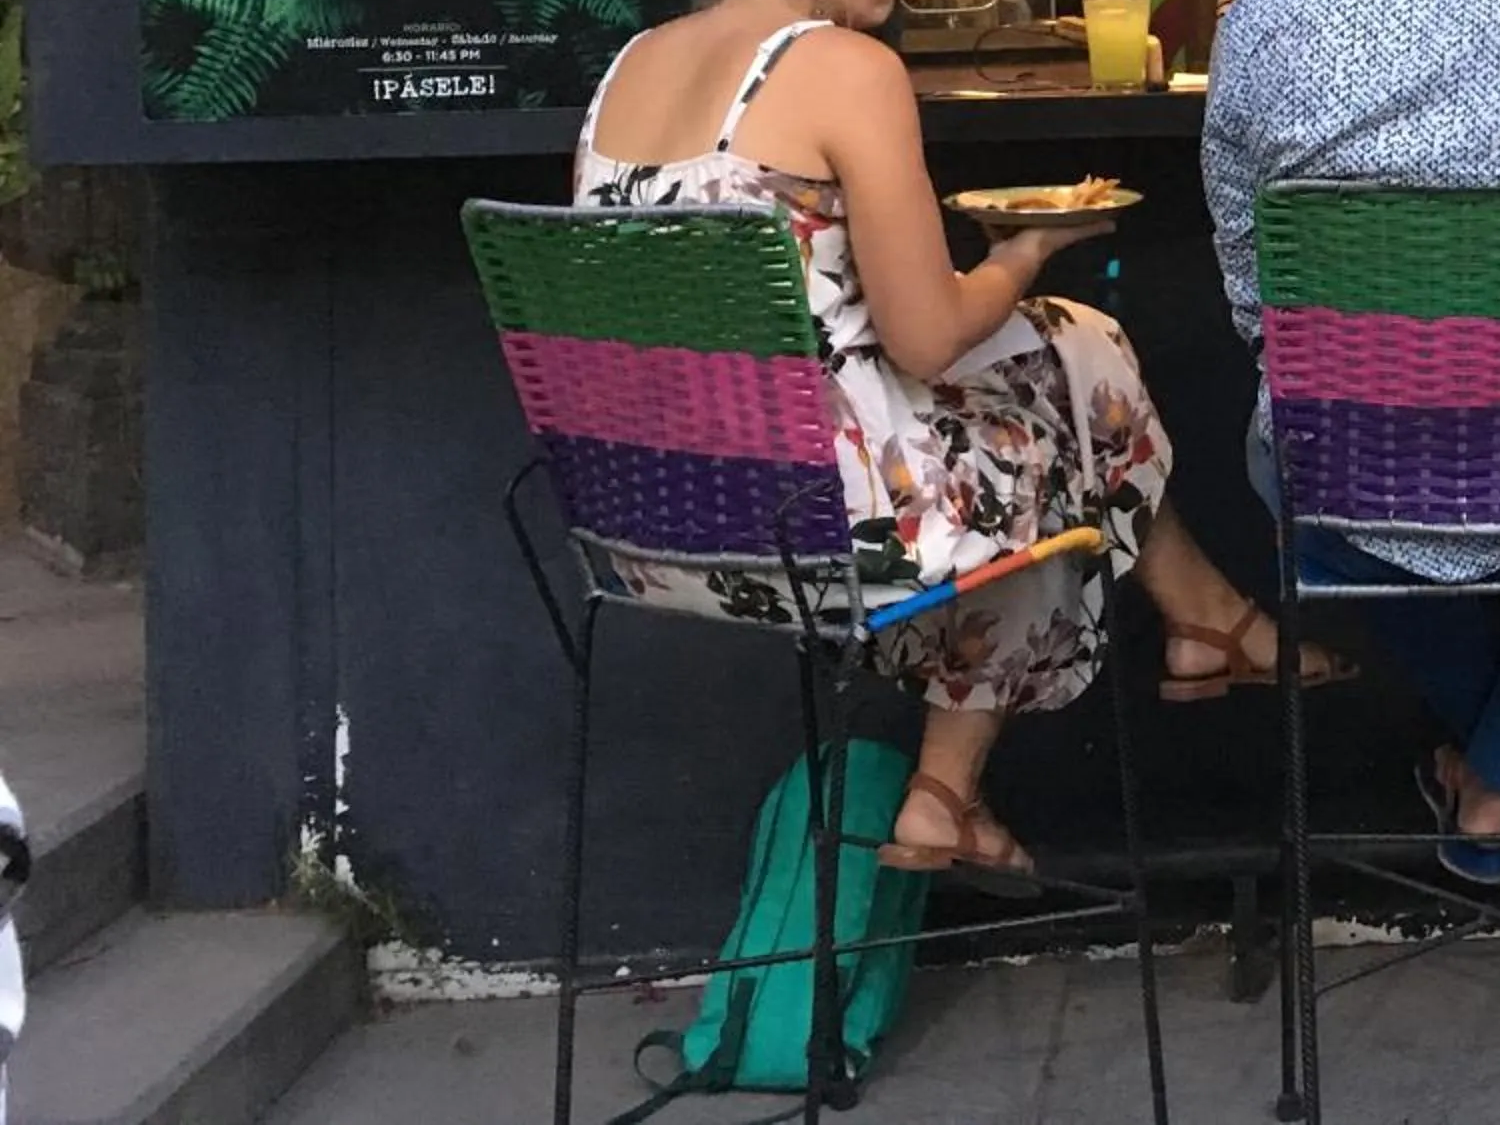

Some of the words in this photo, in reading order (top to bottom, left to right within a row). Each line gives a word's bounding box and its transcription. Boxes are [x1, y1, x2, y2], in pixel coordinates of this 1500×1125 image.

[382, 51, 412, 63] 6:30
[425, 50, 456, 62] 11:45
[460, 49, 480, 61] PM
[374, 72, 495, 101] ¡PÁSELE!
